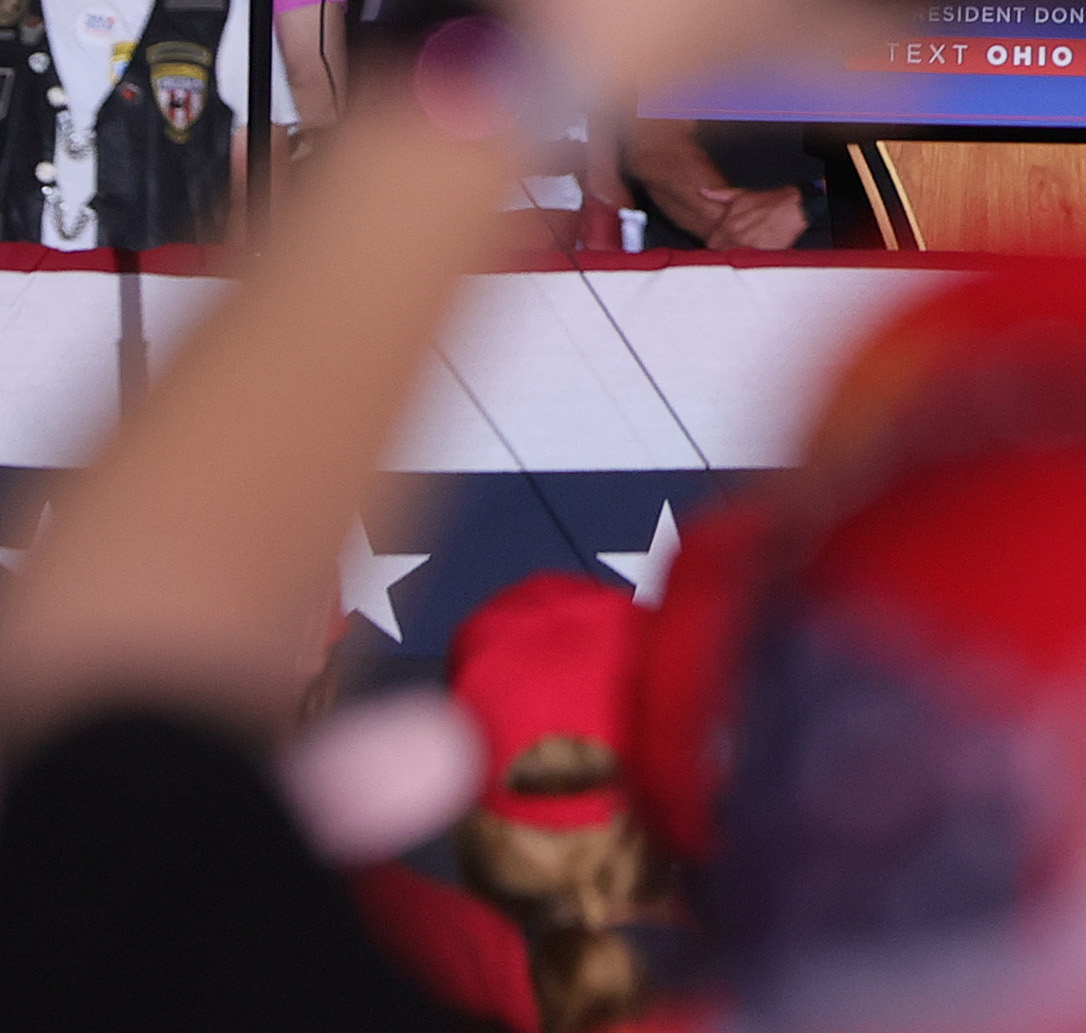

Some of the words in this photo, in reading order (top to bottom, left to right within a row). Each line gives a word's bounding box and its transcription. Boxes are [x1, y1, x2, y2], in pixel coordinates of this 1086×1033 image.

[914, 6, 1026, 23] ESIDENT
[887, 42, 968, 65] TEXT
[986, 44, 1073, 67] OHIO
